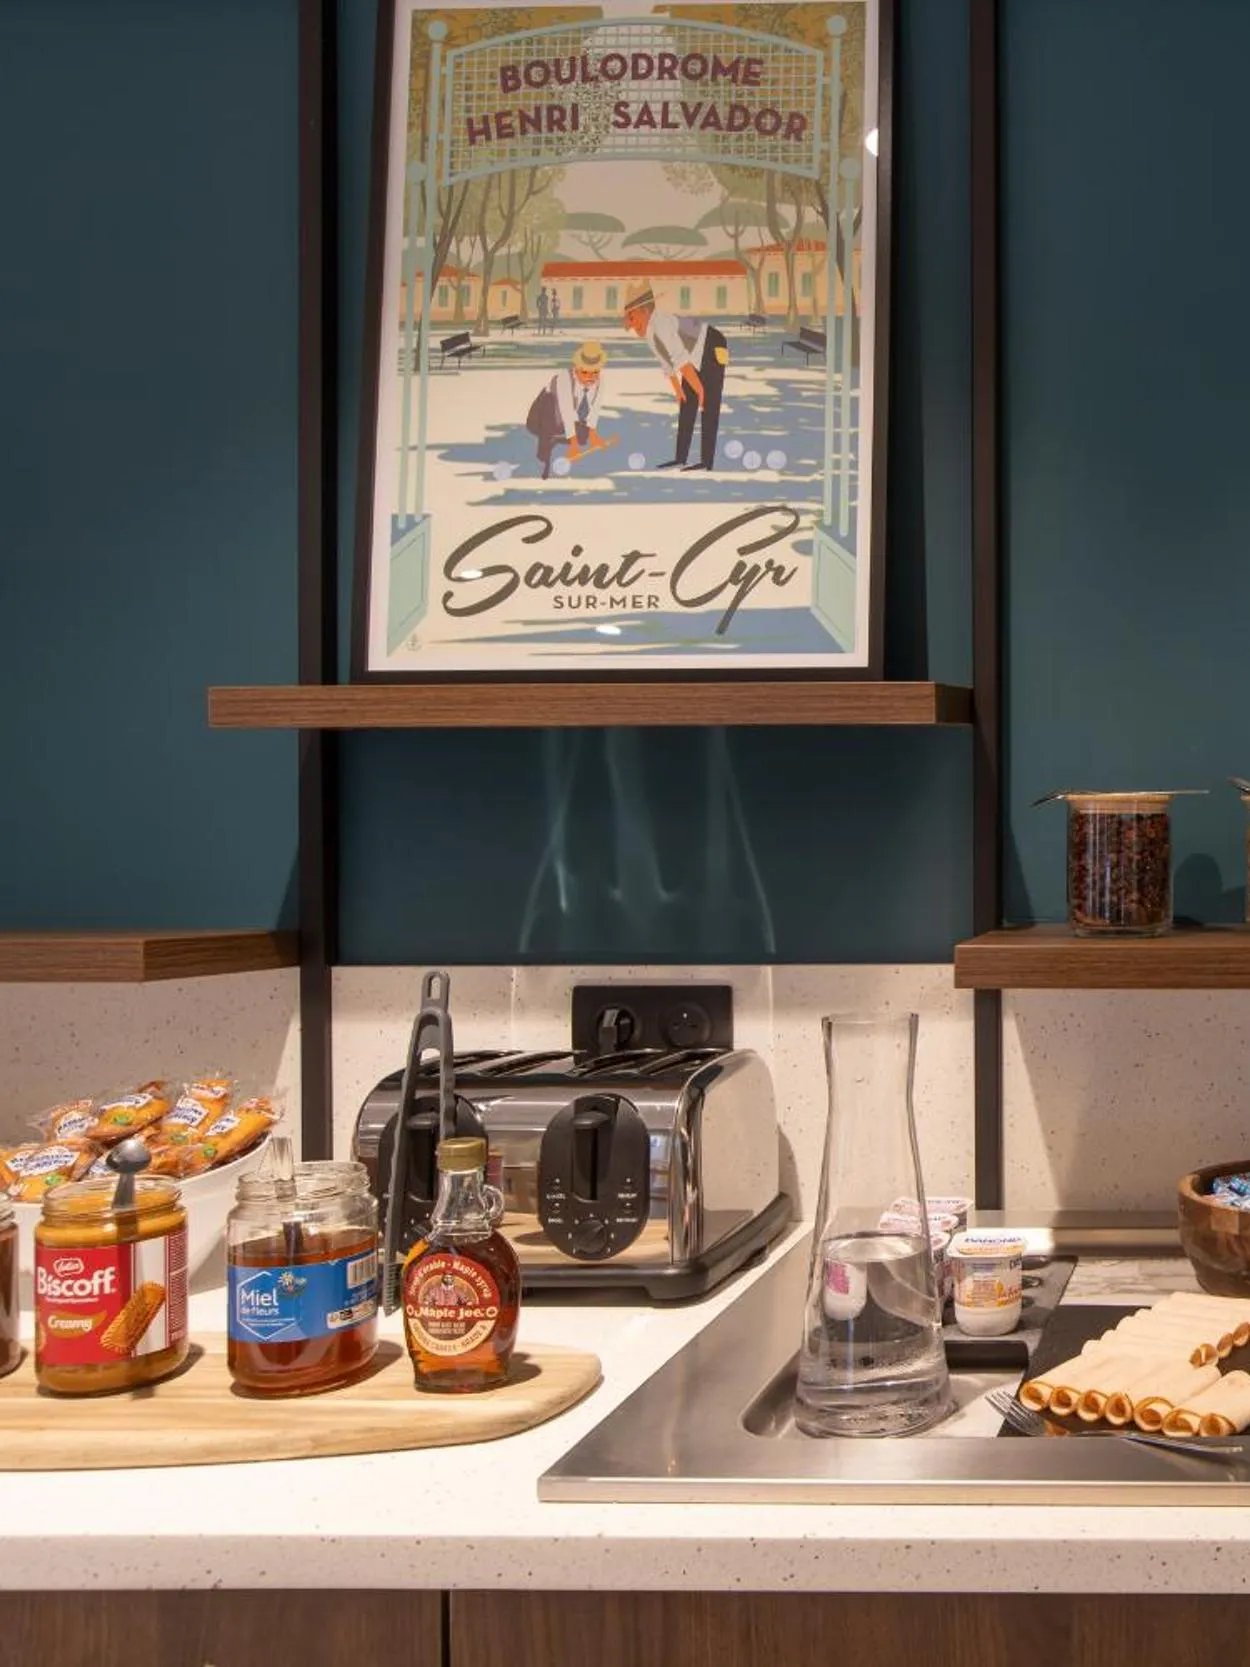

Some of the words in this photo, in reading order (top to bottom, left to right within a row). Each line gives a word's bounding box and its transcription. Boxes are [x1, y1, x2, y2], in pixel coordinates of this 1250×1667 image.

[499, 52, 764, 94] BOULODROME
[466, 105, 579, 147] HENRI
[611, 100, 808, 142] SALVADOR
[441, 505, 800, 637] Saint-Cyr
[553, 594, 660, 610] SUR-MER
[37, 1266, 116, 1297] Biscoff
[240, 1288, 279, 1307] Miel
[47, 1315, 93, 1332] Creamy
[415, 1306, 456, 1319] Maple
